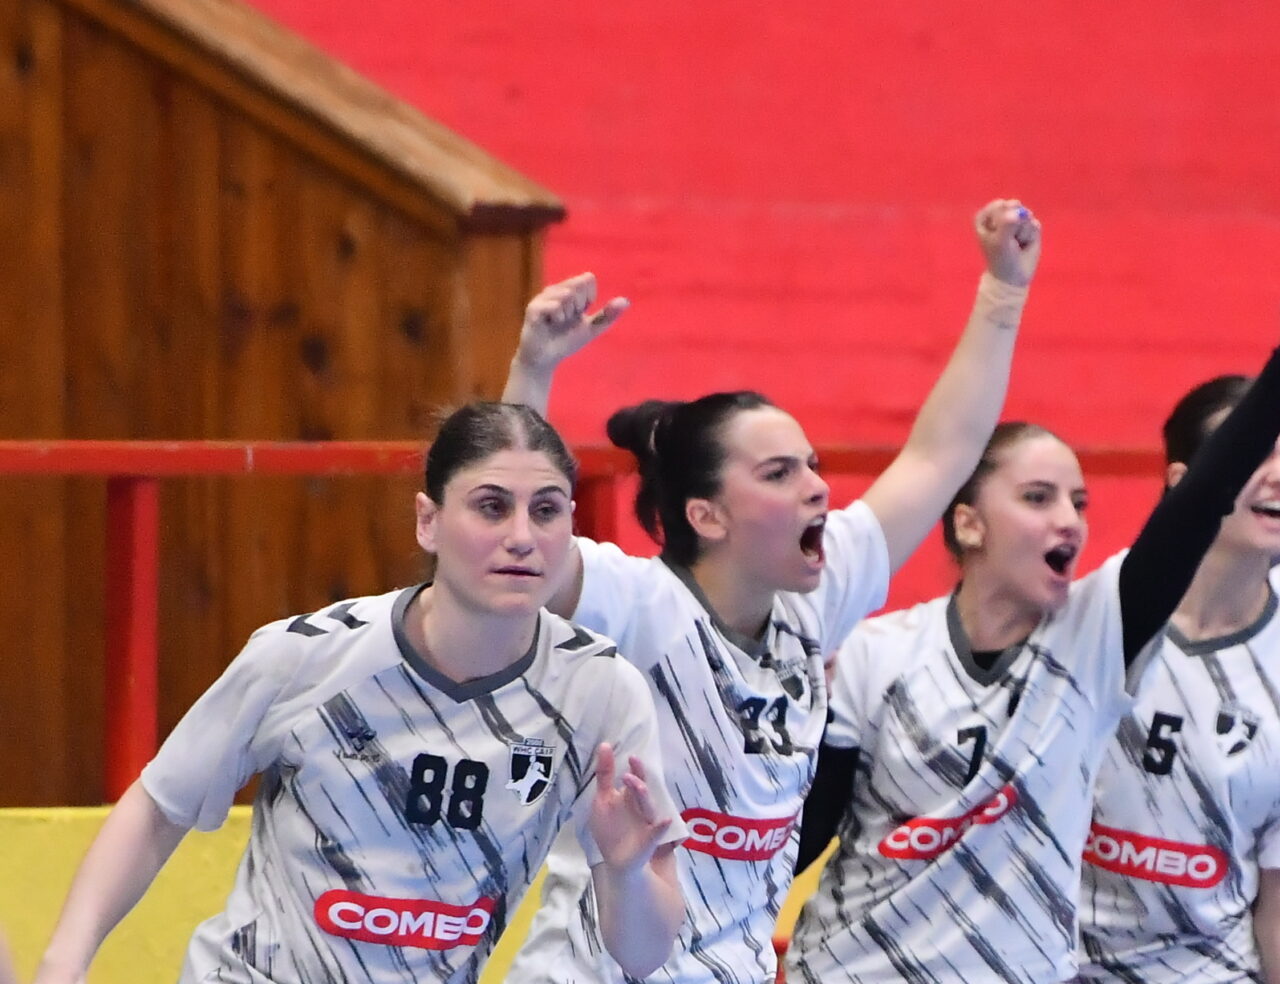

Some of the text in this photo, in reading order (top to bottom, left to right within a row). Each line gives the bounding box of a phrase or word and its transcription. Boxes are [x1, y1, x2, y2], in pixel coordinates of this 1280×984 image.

[957, 725, 987, 788] 7
[1143, 711, 1184, 776] 5
[406, 752, 489, 831] 88
[327, 901, 491, 942] COMBO
